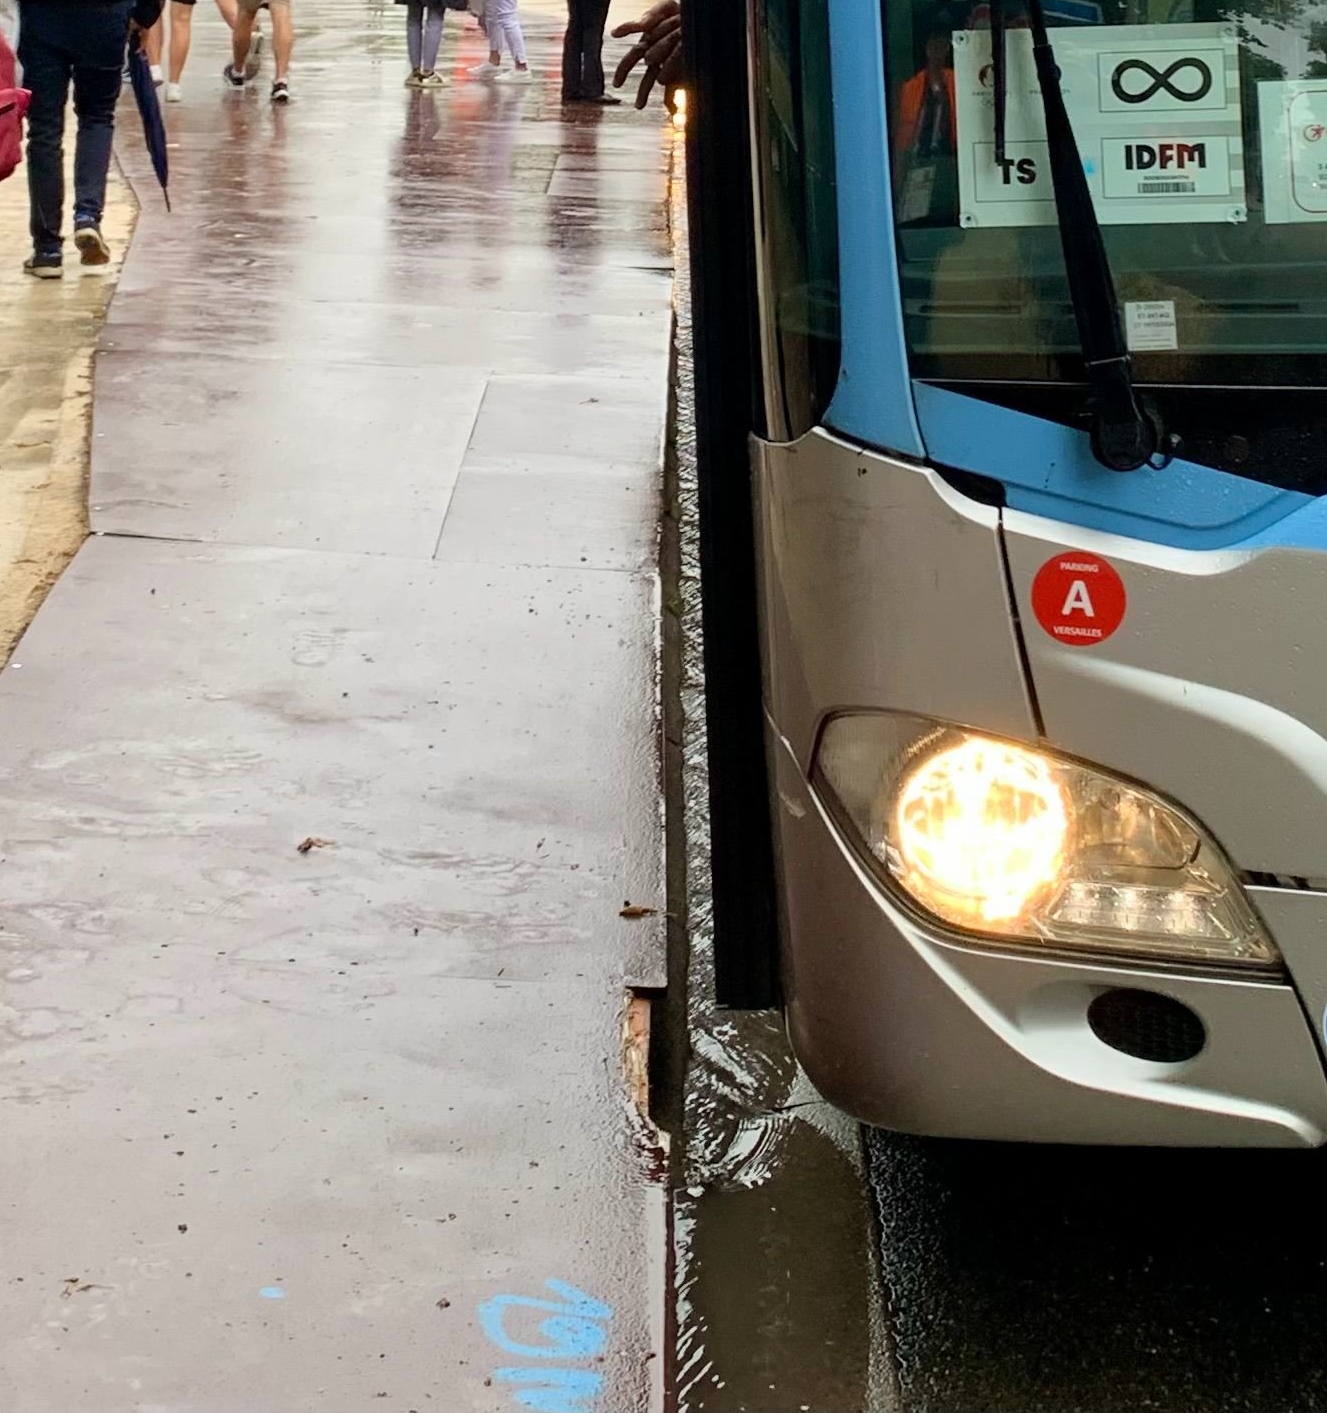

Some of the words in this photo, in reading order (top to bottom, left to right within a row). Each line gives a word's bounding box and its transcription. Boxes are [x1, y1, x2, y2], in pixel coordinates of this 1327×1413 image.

[1124, 142, 1207, 171] IDFM
[1000, 158, 1037, 185] TS
[1060, 562, 1099, 573] PARKING
[1061, 580, 1094, 617] A
[1053, 626, 1102, 637] VERSAILLES
